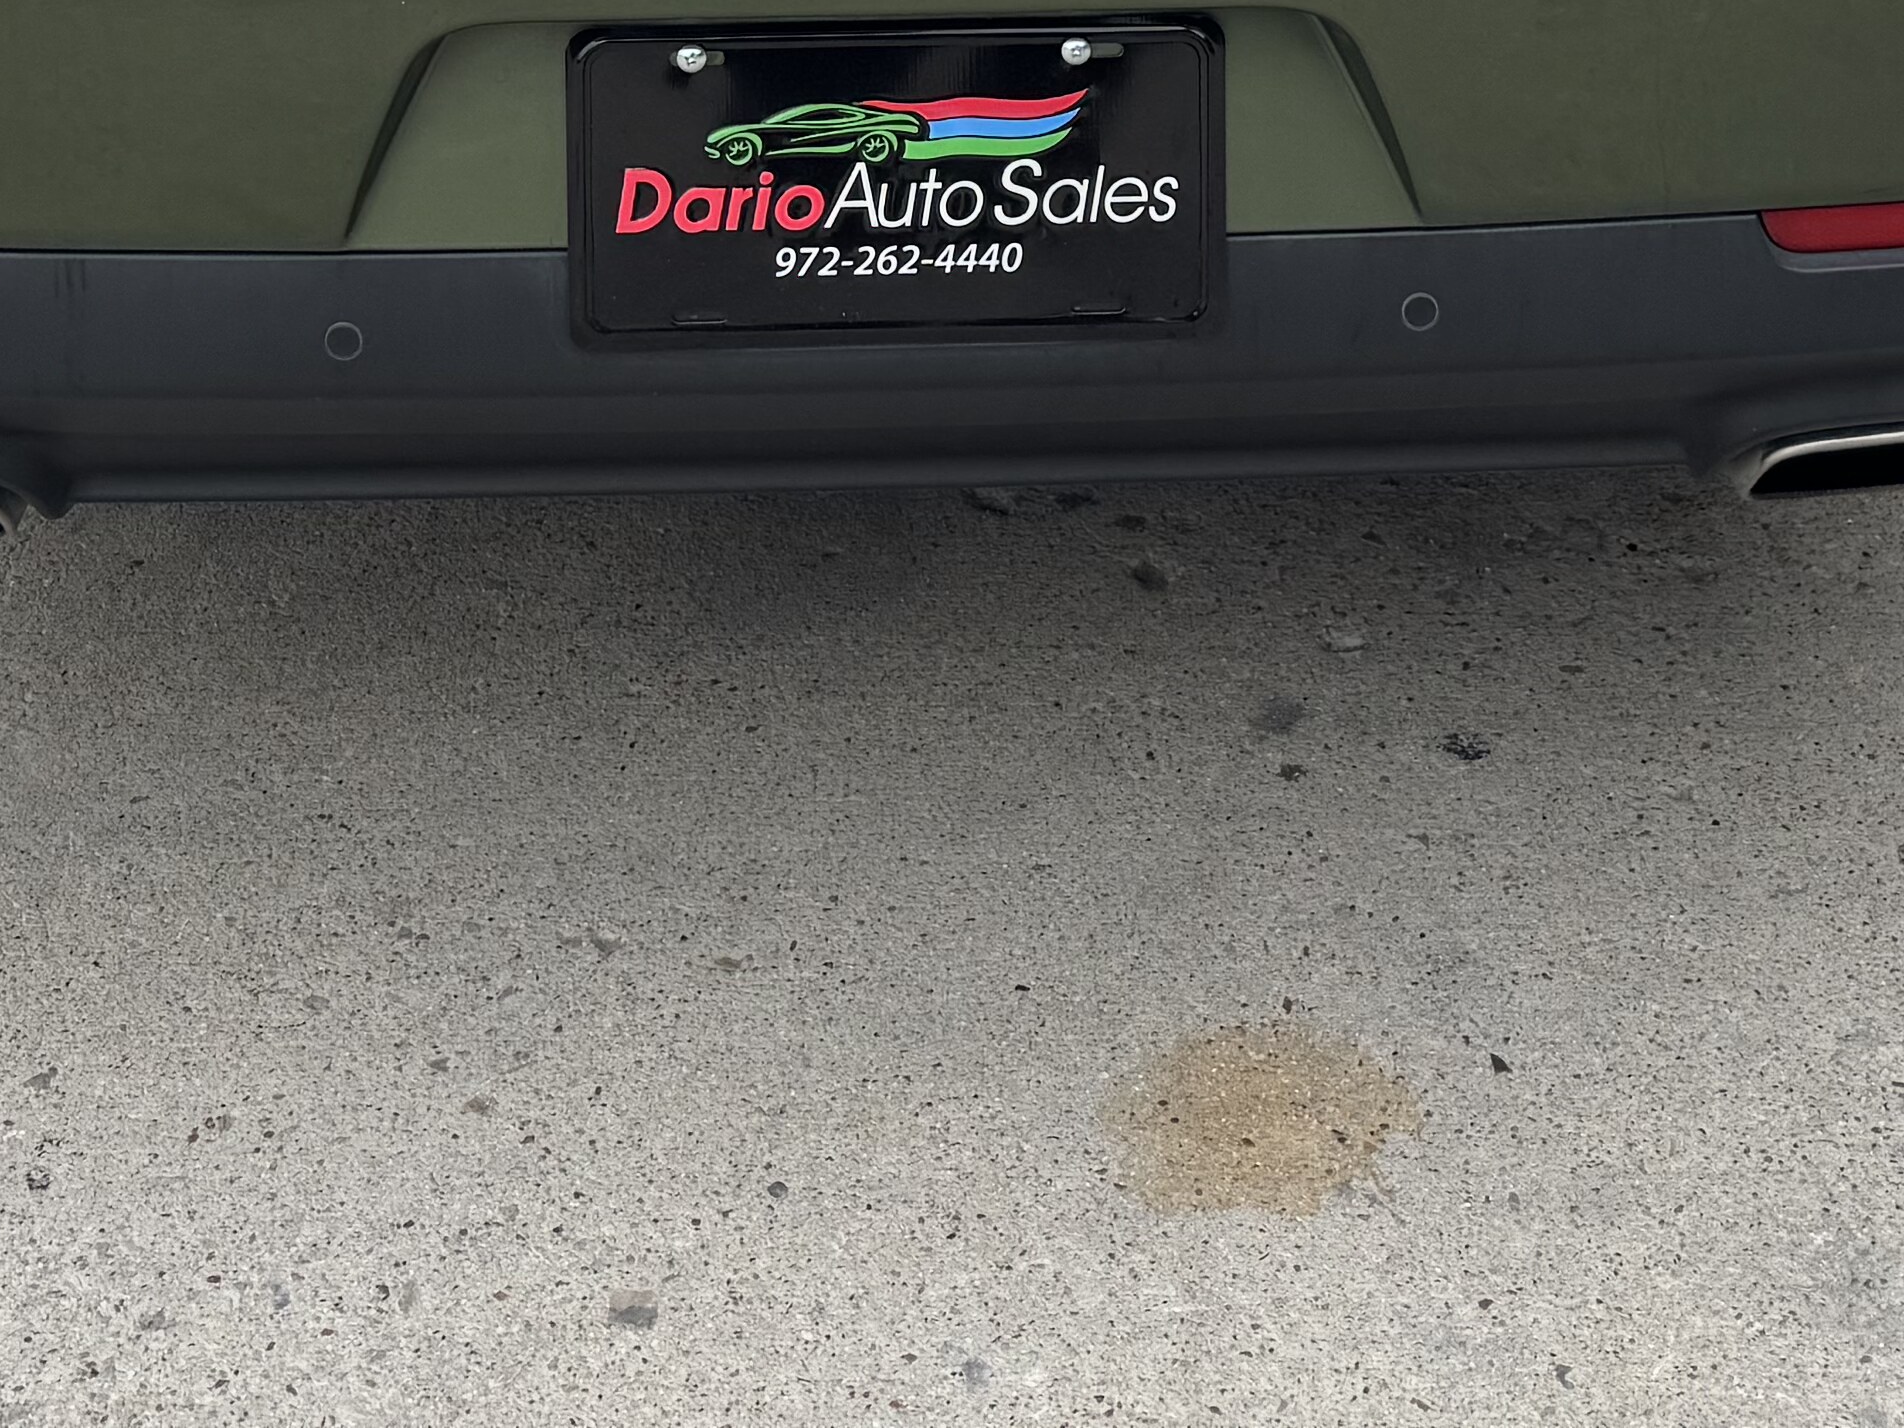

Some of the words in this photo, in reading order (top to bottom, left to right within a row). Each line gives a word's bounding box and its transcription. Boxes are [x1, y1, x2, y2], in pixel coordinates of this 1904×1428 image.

[615, 167, 825, 234] Dario
[824, 161, 984, 230] Auto
[993, 158, 1179, 226] Sales
[774, 242, 1024, 278] 972-262-4440
